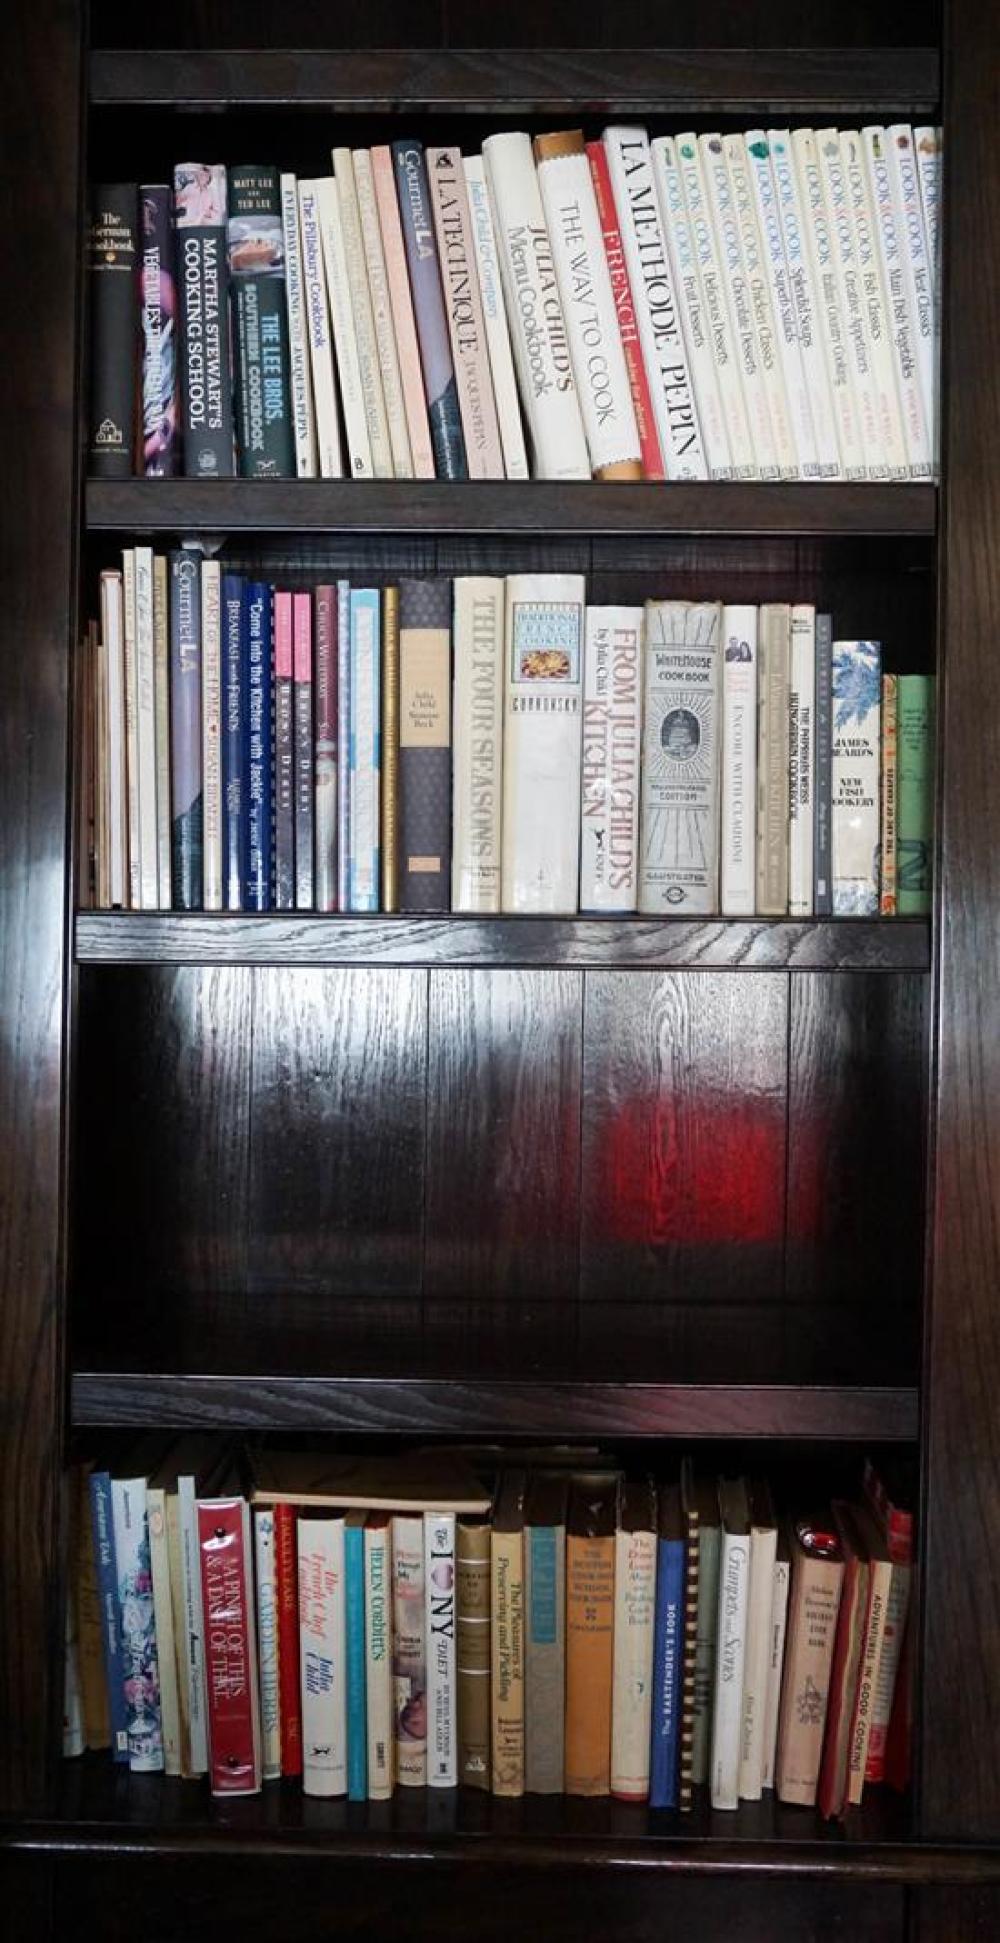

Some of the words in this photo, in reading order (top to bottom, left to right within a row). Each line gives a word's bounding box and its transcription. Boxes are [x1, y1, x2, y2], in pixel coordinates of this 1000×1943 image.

[259, 178, 273, 187] LEE
[620, 142, 646, 177] LA
[828, 163, 846, 207] LOOK
[847, 165, 866, 208] LOOK
[303, 195, 316, 219] The
[403, 149, 428, 229] Gourmet
[437, 178, 456, 209] LA
[874, 160, 892, 204] LOOK
[883, 213, 903, 262] COOK
[899, 158, 917, 202] LOOK
[908, 211, 927, 260] COOK
[285, 190, 298, 251] EVERYDAY
[415, 230, 434, 260] LA
[560, 201, 583, 247] THE
[836, 215, 854, 262] COOK
[856, 218, 875, 265] COOK
[303, 221, 320, 279] Pillsbury
[508, 227, 531, 283] Menu
[628, 186, 678, 351] METHODE
[186, 238, 204, 338] COOKING
[202, 238, 220, 319] MARTHA
[288, 256, 301, 314] COOKING
[441, 210, 478, 354] TECHNIQUE
[569, 251, 595, 310] WAY
[603, 229, 637, 342] FRENCH
[262, 313, 280, 343] THE
[310, 283, 327, 348] Cookbook
[532, 227, 559, 292] JULIA
[546, 298, 574, 391] CHILD'S
[579, 315, 601, 347] TO
[263, 347, 282, 374] LEE
[515, 288, 551, 398] Cookbook
[188, 342, 206, 430] SCHOOL
[206, 323, 223, 429] STEWART'S
[264, 378, 284, 425] BROS.
[587, 355, 616, 426] COOK
[249, 366, 265, 451] COOKBOOK
[661, 364, 701, 456] PEPIN
[178, 561, 198, 641] Gourmet
[206, 575, 220, 629] HEART
[472, 595, 497, 653] THE
[179, 643, 197, 673] LA
[250, 666, 263, 685] the
[612, 628, 637, 704] FROM
[206, 679, 220, 723] HOME
[250, 688, 263, 731] Kitchen
[281, 684, 290, 743] BROWN
[299, 689, 310, 747] BROWN
[472, 659, 497, 731] FOUR
[250, 733, 263, 759] with
[583, 699, 609, 817] KITCHEN
[608, 706, 637, 789] JULIA
[732, 705, 744, 757] ENCORE
[834, 738, 869, 747] JAMES
[281, 755, 292, 808] DERBY
[300, 759, 310, 812] DERBY
[470, 737, 495, 857] SEASONS
[732, 762, 743, 793] WITH
[609, 788, 635, 889] CHILD'S
[732, 800, 744, 863] CLAUDINE
[371, 1546, 385, 1591] HELEN
[431, 1548, 454, 1559] I
[210, 1631, 228, 1653] OF
[227, 1633, 244, 1653] OF
[430, 1594, 455, 1640] NY
[666, 1603, 676, 1634] BOOK
[867, 1594, 882, 1660] ADVENTURES
[304, 1650, 320, 1694] Child
[318, 1658, 335, 1693] Julia
[864, 1665, 873, 1678] IN
[859, 1682, 873, 1717] GOOD
[852, 1720, 867, 1774] COOKING
